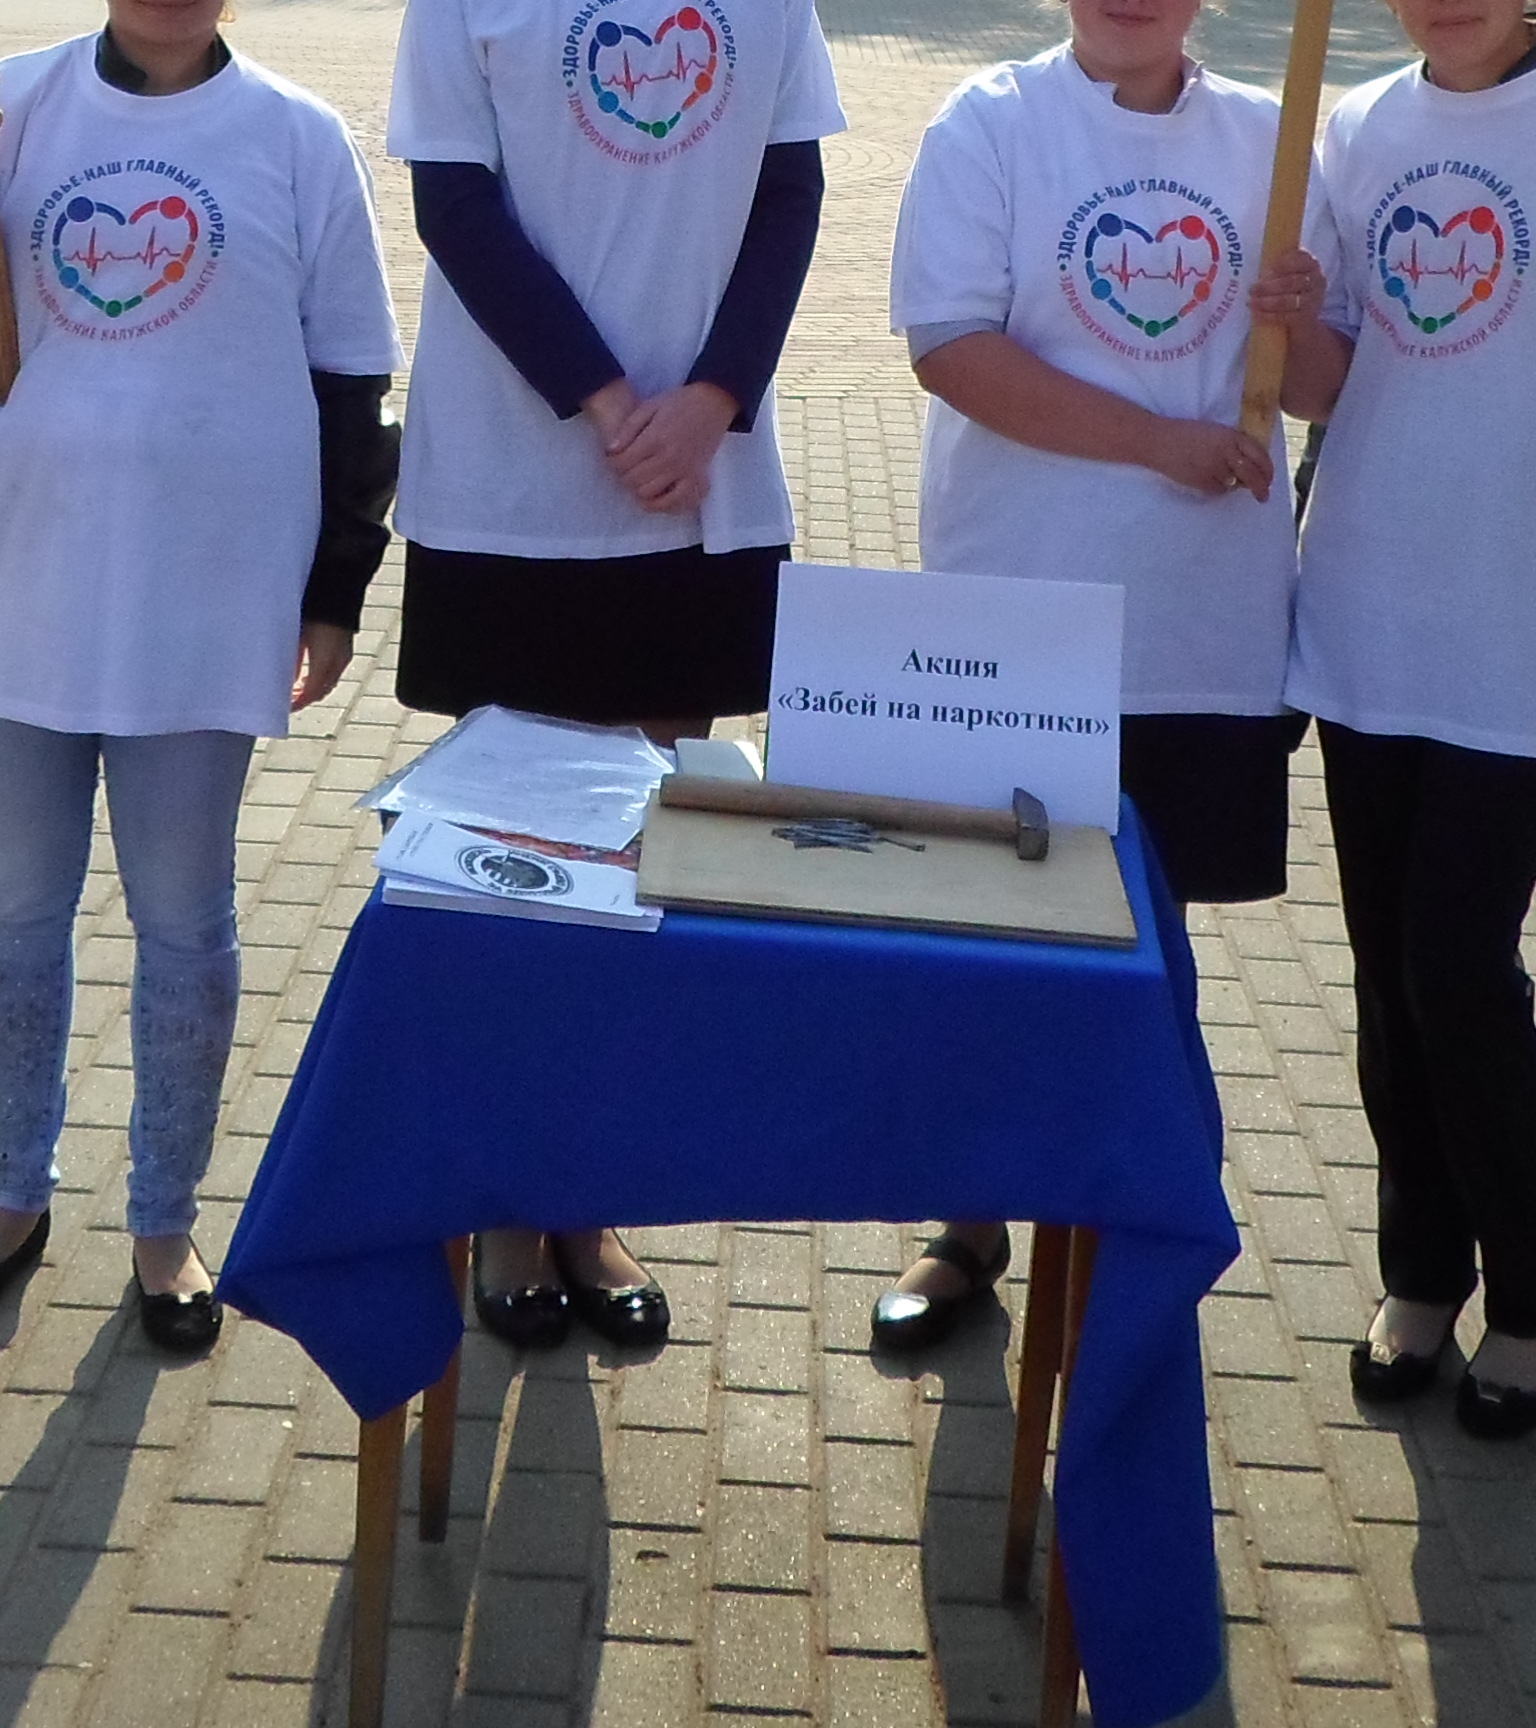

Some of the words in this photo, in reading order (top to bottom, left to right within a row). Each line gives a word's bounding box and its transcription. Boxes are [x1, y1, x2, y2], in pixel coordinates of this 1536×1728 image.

[704, 0, 737, 64] РЕКОРД!
[126, 159, 202, 192] ГЛАВНЫЙ
[195, 187, 225, 250] РЕКОРД!
[1139, 178, 1212, 210] ГЛАВНЫЙ
[1210, 206, 1243, 268] РЕКОРД!
[1442, 160, 1513, 201] ГЛАВНЫЙ
[1503, 197, 1531, 268] РЕКОРД!
[901, 648, 999, 680] Акция
[777, 686, 878, 719] «Забей
[887, 700, 921, 722] на
[930, 703, 1111, 737] наркотики»
